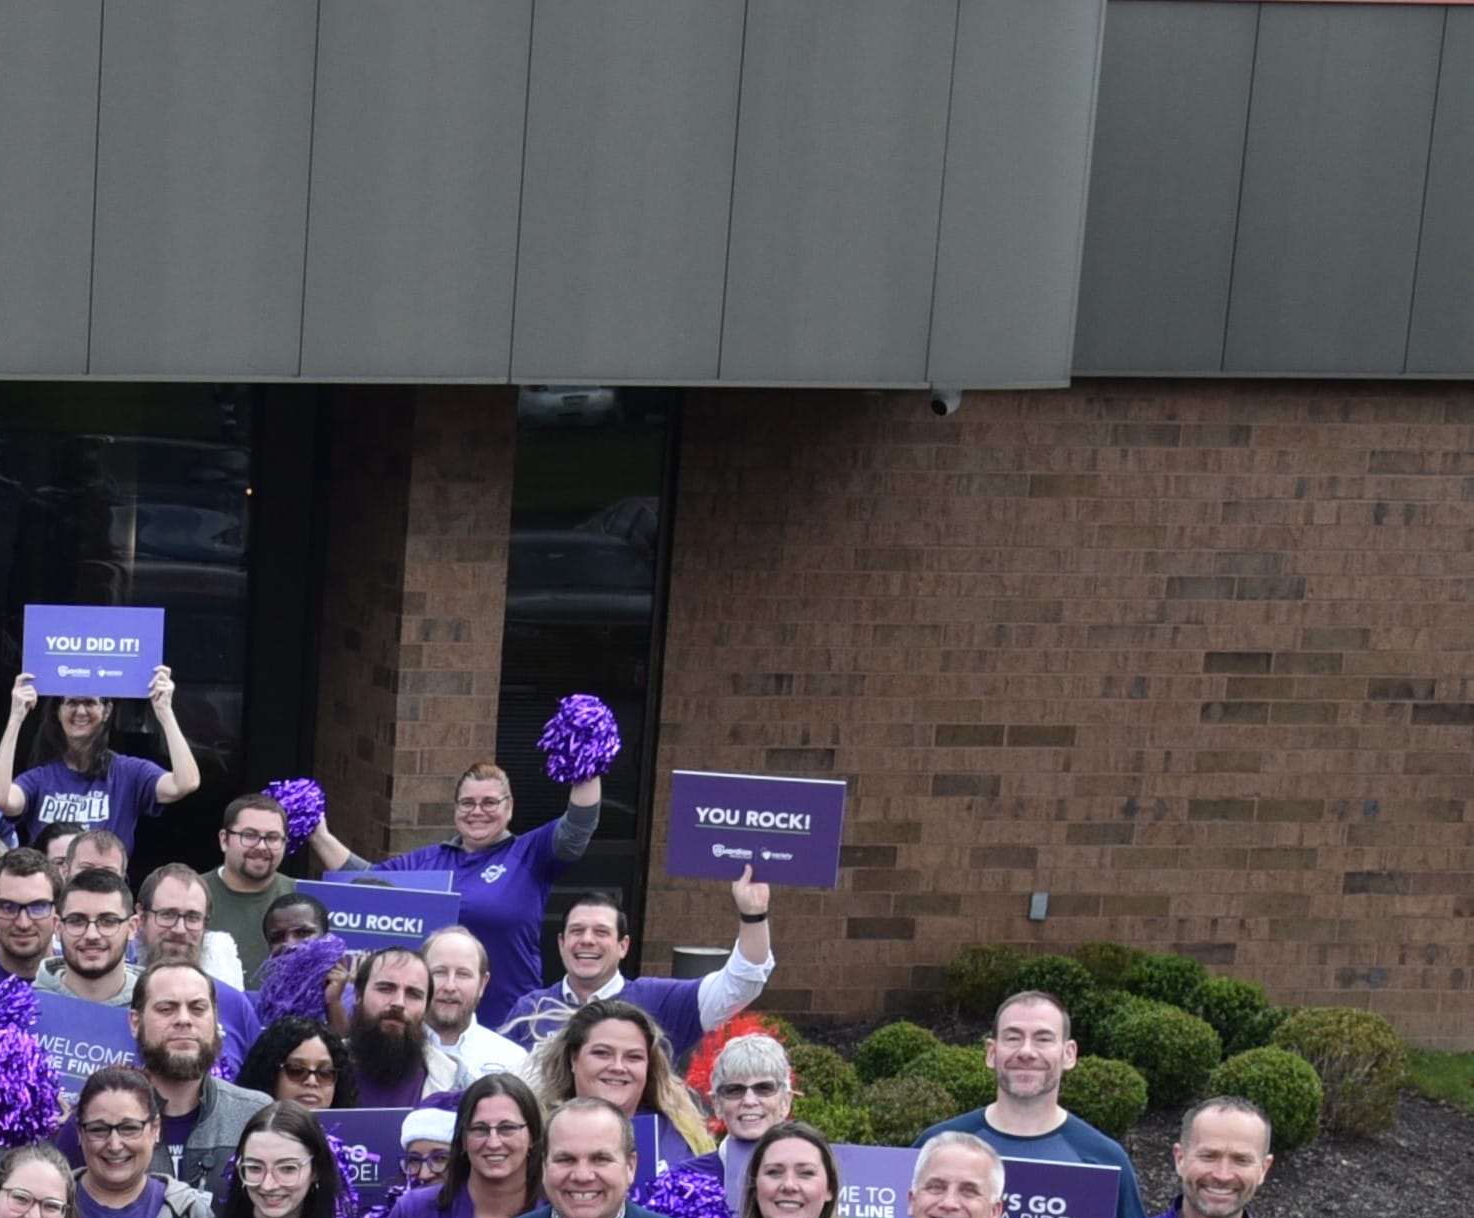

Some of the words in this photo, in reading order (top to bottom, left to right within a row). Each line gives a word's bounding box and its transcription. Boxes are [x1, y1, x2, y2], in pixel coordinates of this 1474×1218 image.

[45, 636, 82, 652] YOU
[86, 637, 116, 653] DID
[119, 638, 140, 653] IT!
[695, 806, 741, 826] YOU
[745, 810, 811, 831] ROCK!
[328, 911, 362, 928] OU
[365, 914, 424, 934] ROCK!
[866, 1186, 896, 1205] TO
[1028, 1196, 1066, 1215] GO
